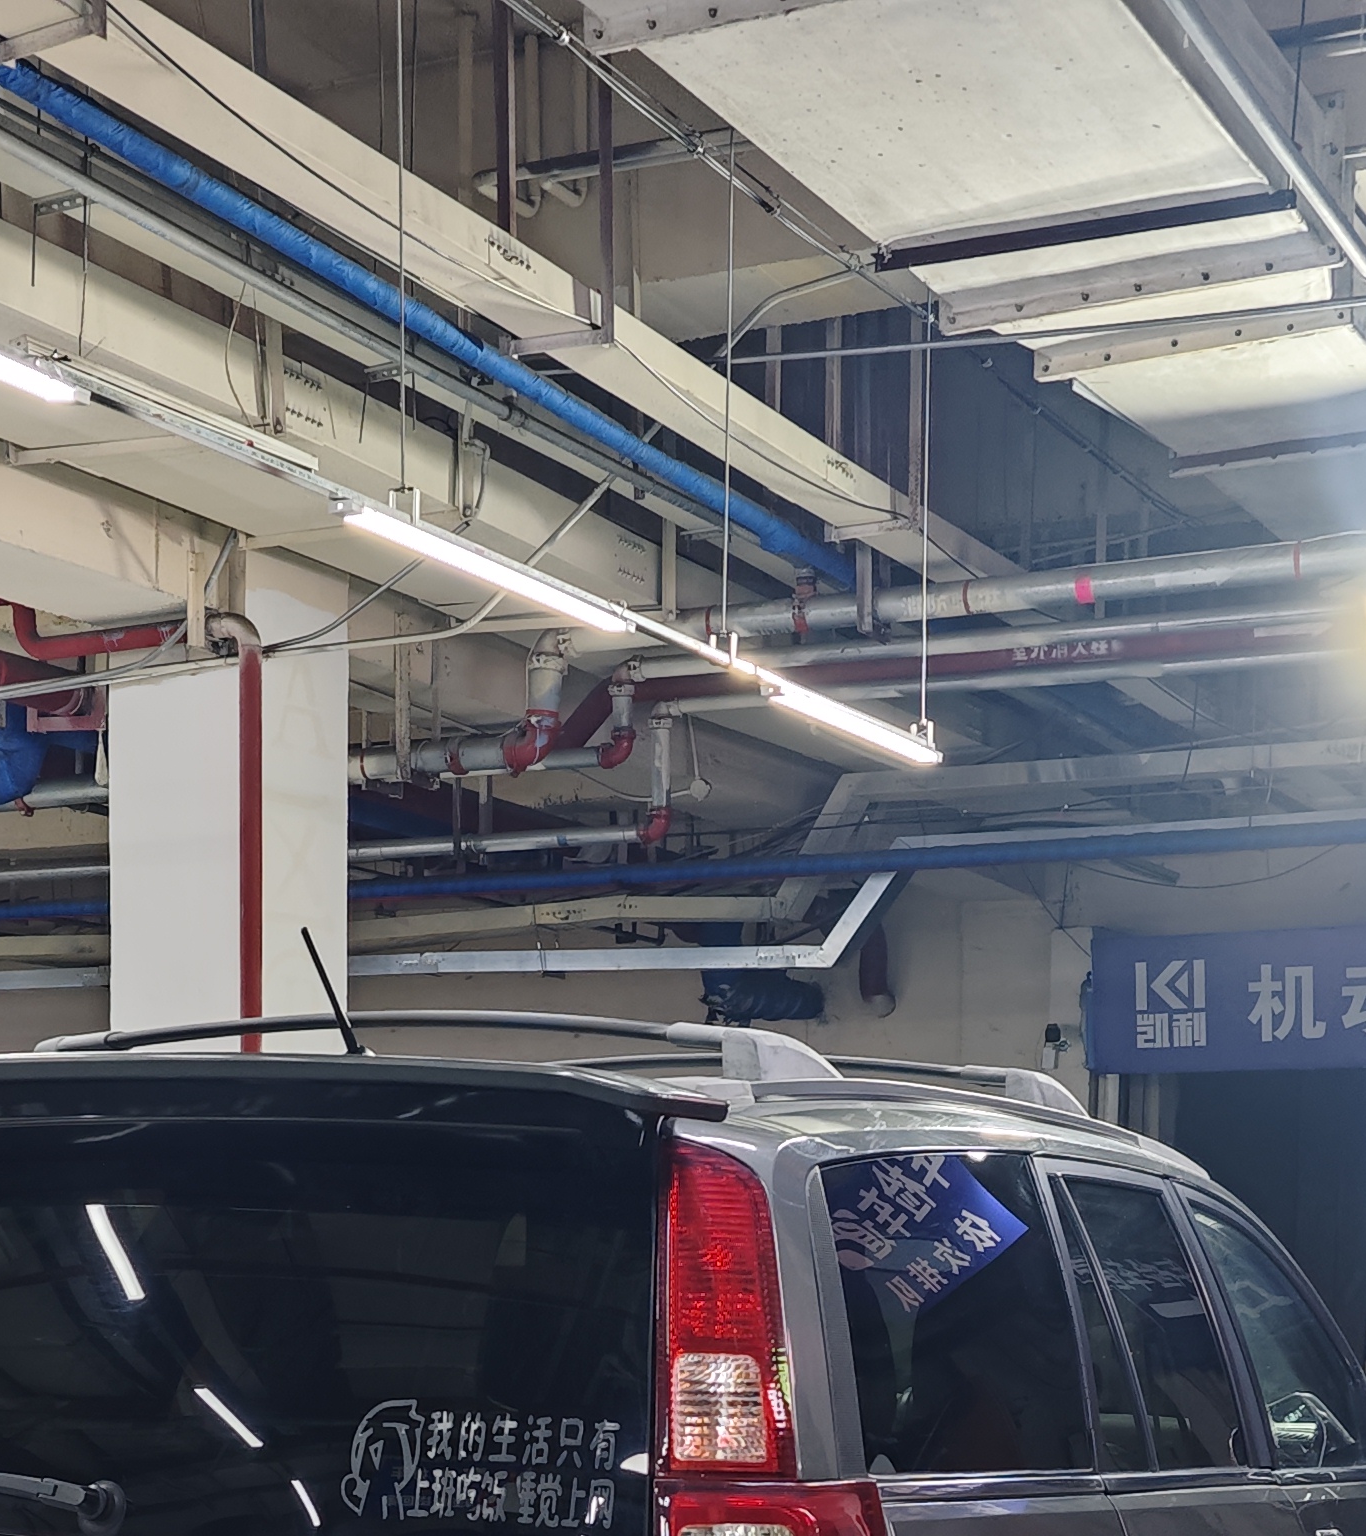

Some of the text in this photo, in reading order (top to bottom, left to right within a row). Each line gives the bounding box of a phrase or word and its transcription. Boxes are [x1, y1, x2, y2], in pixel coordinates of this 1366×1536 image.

[1136, 1011, 1207, 1049] 凯利
[426, 1410, 621, 1471] 我的生活只有
